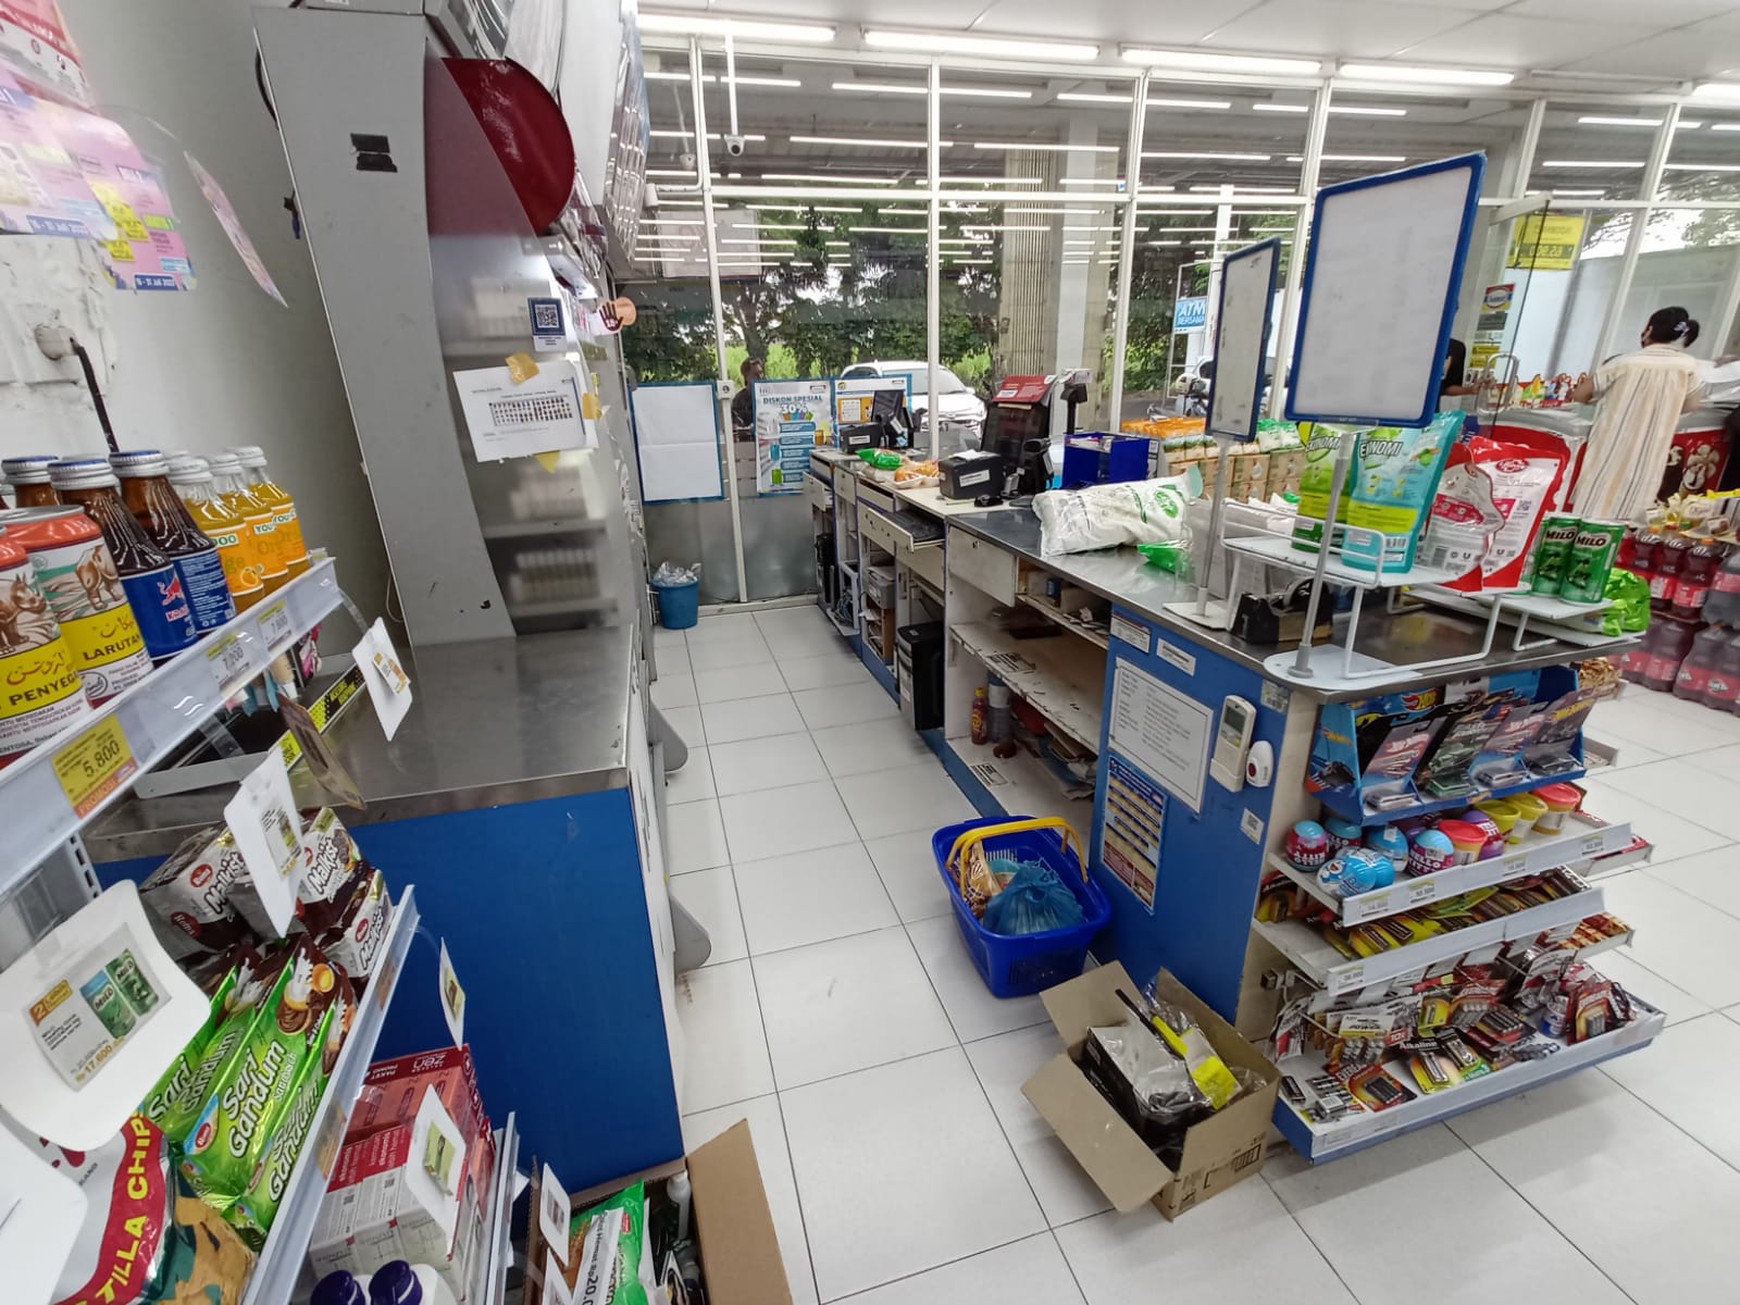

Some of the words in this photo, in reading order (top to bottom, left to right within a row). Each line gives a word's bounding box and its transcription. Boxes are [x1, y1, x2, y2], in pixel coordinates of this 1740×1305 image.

[1179, 302, 1206, 317] ATM
[763, 396, 793, 405] DISKON
[793, 395, 823, 404] SPESIAL
[781, 403, 808, 414] 30%
[1545, 529, 1575, 541] MILO
[1575, 536, 1607, 547] MILO
[307, 837, 340, 895] Malkist
[1408, 859, 1440, 874] KITT
[1409, 849, 1441, 869] HELLO
[204, 851, 245, 914] Malkist
[359, 906, 385, 970] Malkist
[34, 1005, 46, 1017] 2
[1400, 1039, 1438, 1051] Alkaline
[413, 1053, 447, 1070] zen
[178, 1030, 238, 1115] Gandum
[149, 1055, 192, 1123] Sari
[223, 1047, 258, 1121] Sari
[229, 1039, 287, 1158] Gandum
[269, 1081, 320, 1202] Gandum
